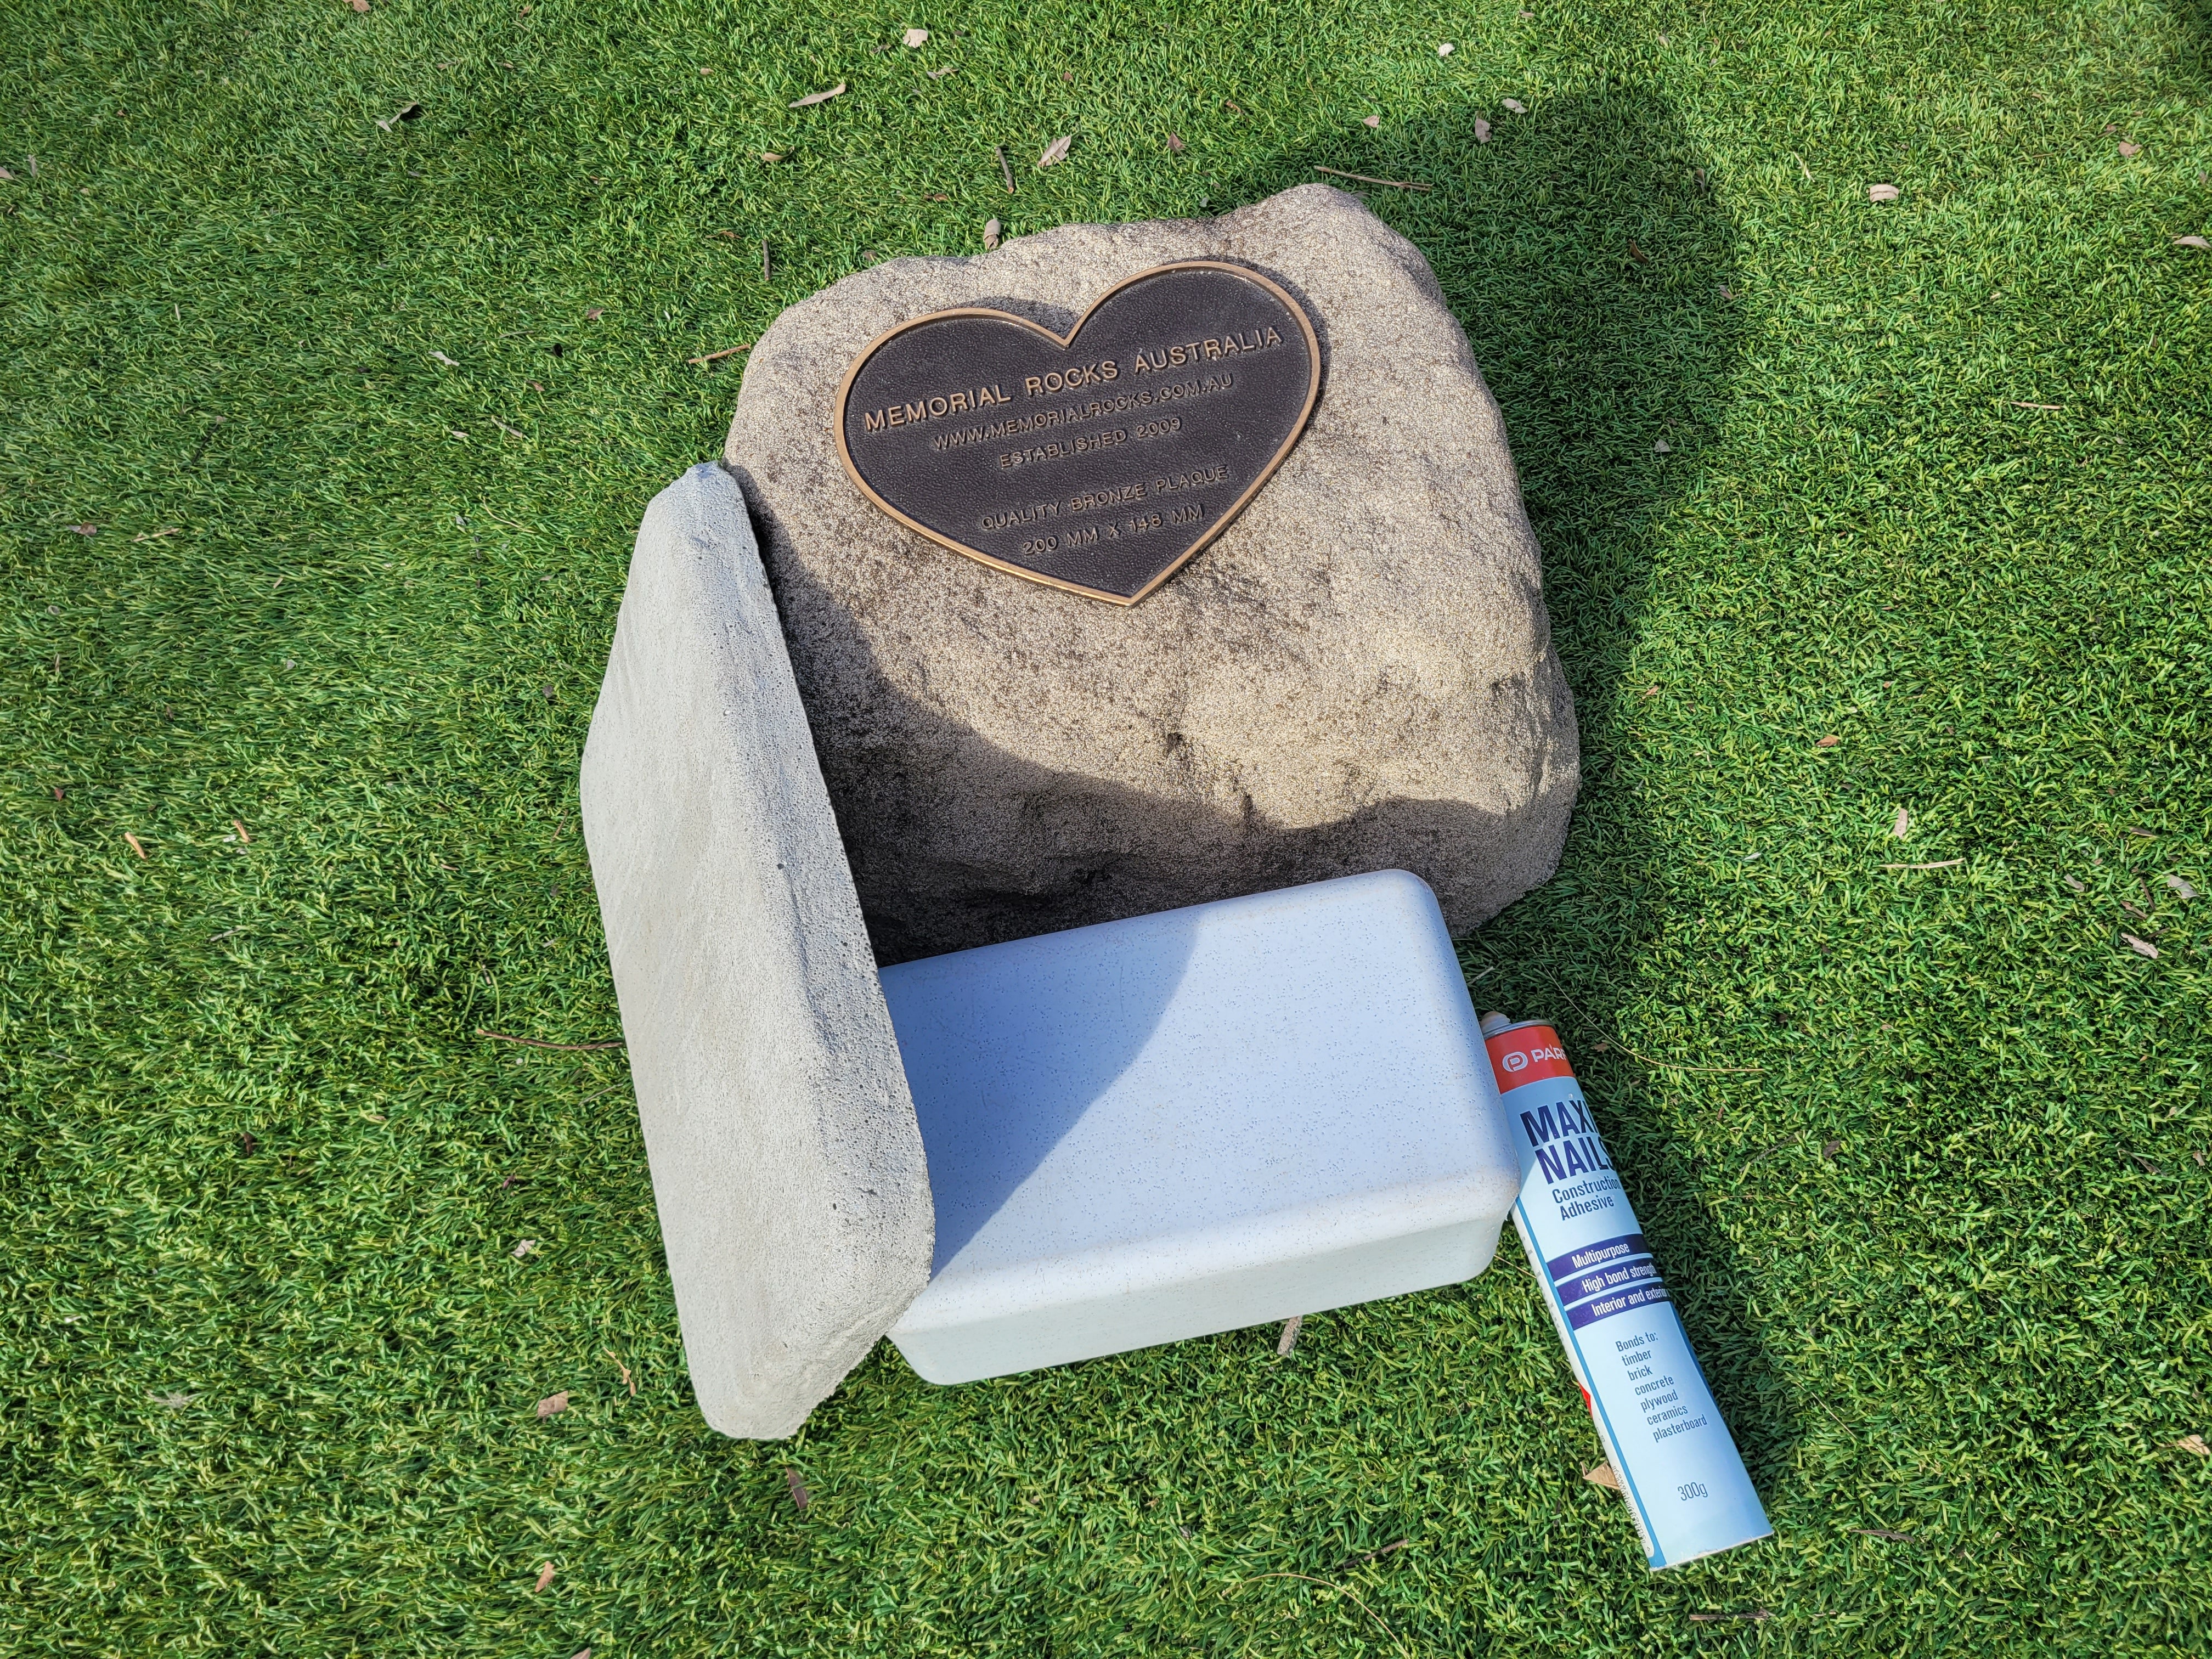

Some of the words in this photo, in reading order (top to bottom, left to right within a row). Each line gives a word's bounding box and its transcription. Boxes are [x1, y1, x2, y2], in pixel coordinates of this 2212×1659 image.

[865, 385, 1011, 431] MEMORIAL
[1025, 360, 1118, 396] ROCKS
[1135, 327, 1282, 374] AUSTRALIA
[934, 373, 1233, 450] WWW.MEMORIALROCKS.COM.AU
[1000, 429, 1127, 467] ESTABLISHED
[1136, 417, 1182, 438] 2009
[981, 502, 1060, 529] QUALITY
[1071, 483, 1147, 511] BRONZE
[1155, 466, 1229, 492] PLAQUE
[1023, 537, 1057, 555] 200
[1066, 528, 1098, 546] MM
[1108, 522, 1120, 538] X
[1129, 514, 1162, 532] 148
[1172, 504, 1204, 524] MM
[1552, 1176, 1621, 1204] Construction
[1560, 1195, 1615, 1221] Adhesive
[1572, 1243, 1629, 1268] Multipurpose
[1582, 1276, 1605, 1293] High
[1605, 1267, 1629, 1285] bond
[1630, 1262, 1657, 1277] strength
[1592, 1296, 1627, 1317] Interior
[1628, 1289, 1645, 1305] and
[1615, 1335, 1645, 1352] Bonds
[1645, 1332, 1658, 1342] to:
[1622, 1350, 1651, 1366] timber
[1627, 1365, 1653, 1381] brick
[1635, 1375, 1674, 1395] concrete
[1640, 1389, 1678, 1413] plywood
[1647, 1406, 1688, 1425] ceramics
[1653, 1414, 1707, 1443] plasterboard
[1678, 1482, 1708, 1500] 300g
